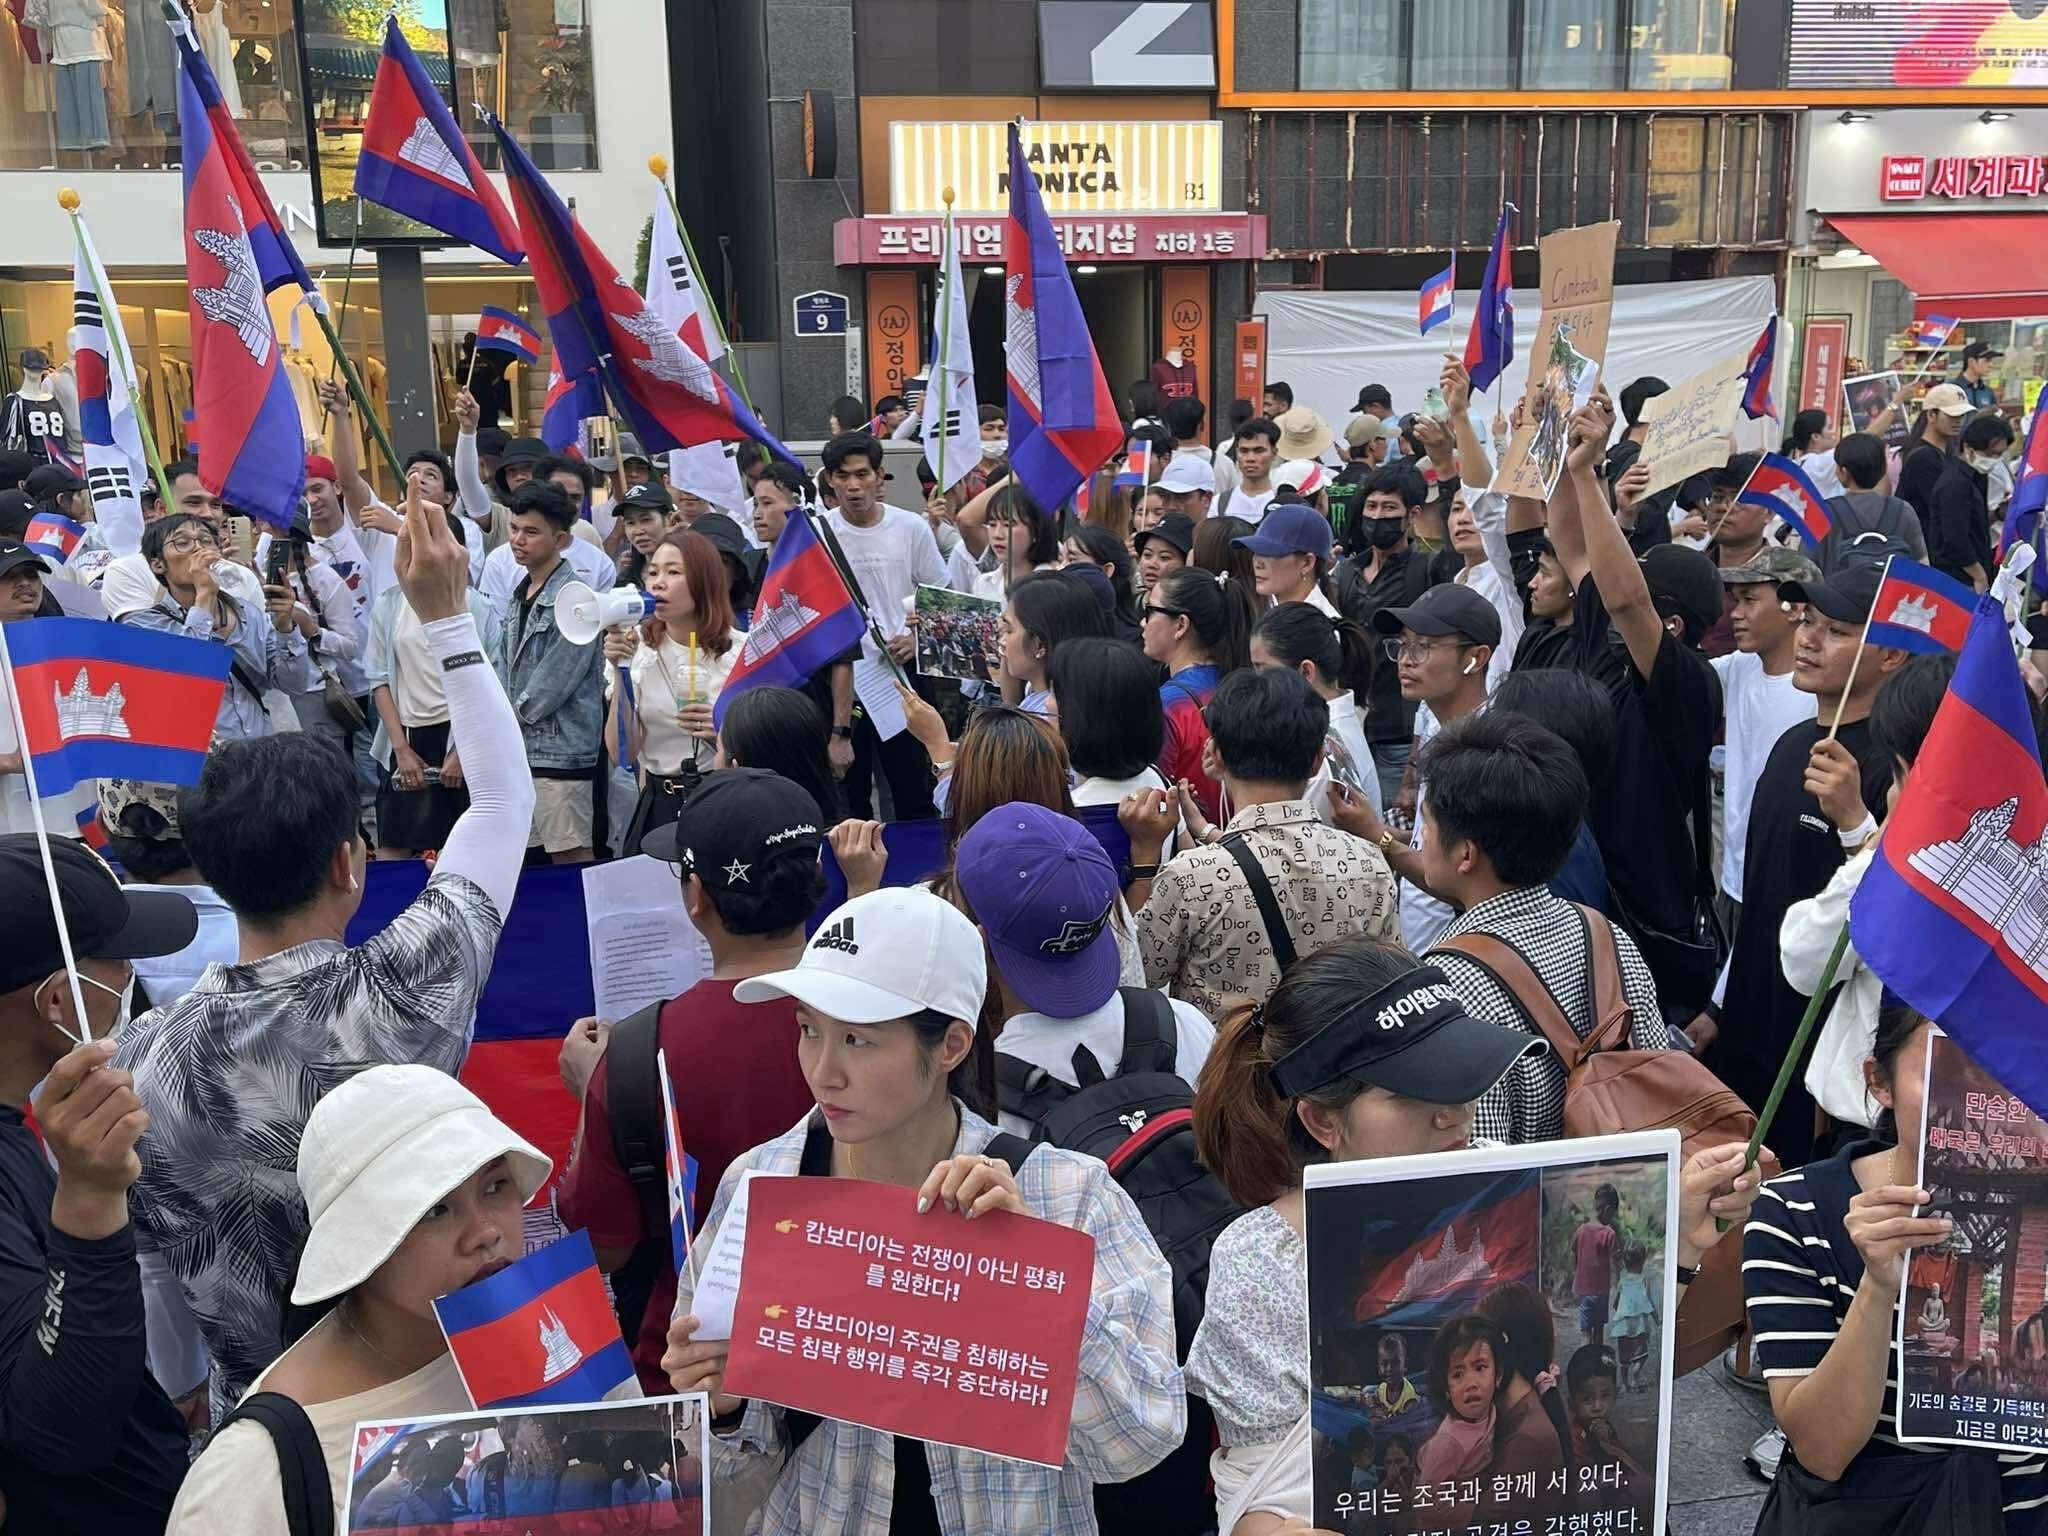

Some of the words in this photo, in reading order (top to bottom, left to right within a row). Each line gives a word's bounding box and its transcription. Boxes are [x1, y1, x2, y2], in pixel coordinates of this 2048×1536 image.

[1012, 142, 1112, 164] ANTA
[1932, 156, 2048, 198] 세계과
[1184, 183, 1205, 200] B1
[1052, 224, 1137, 255] 티지샵
[1156, 232, 1197, 253] 지하
[1202, 231, 1235, 253] 1층
[816, 313, 829, 331] 9
[28, 411, 64, 437] 88
[1255, 803, 1268, 828] Dio
[1282, 805, 1303, 818] Dior
[1258, 845, 1283, 858] Dior
[1294, 836, 1306, 863] Dior
[1189, 857, 1217, 868] Dior
[1160, 903, 1178, 926] Dior
[1286, 908, 1307, 921] Dior
[1321, 896, 1334, 922] Dior
[1349, 905, 1367, 918] Dor
[1372, 890, 1384, 917] Dior
[1222, 917, 1251, 931] Dior
[813, 936, 859, 955] adidas
[1222, 980, 1249, 994] Dior
[1965, 1092, 2029, 1123] 단순한
[1987, 1133, 2037, 1158] 우리의
[805, 1219, 906, 1262] 캄보디아는
[911, 1243, 973, 1276] 전쟁이
[977, 1256, 1019, 1285] 아닌
[1024, 1265, 1066, 1295] 평화
[866, 1263, 886, 1286] 를
[891, 1268, 961, 1303] 원한다!
[795, 1305, 896, 1348] 캄보디아의
[900, 1329, 962, 1362] 주권을
[966, 1343, 1050, 1380] 침해하는
[756, 1326, 797, 1354] 모든
[801, 1335, 842, 1365] 침략
[846, 1346, 907, 1379] 행위를
[911, 1360, 953, 1389] 즉각
[957, 1369, 1049, 1407] 중단하라!
[1908, 1393, 1944, 1410] 기도의
[1993, 1397, 2046, 1419] 가득했던
[1955, 1419, 1996, 1440] 지금은
[1334, 1487, 1402, 1520] 우리는
[1412, 1477, 1482, 1509] 조국과
[1491, 1470, 1536, 1502] 함께
[1547, 1467, 1567, 1495] 서
[1578, 1460, 1629, 1494] 있다.
